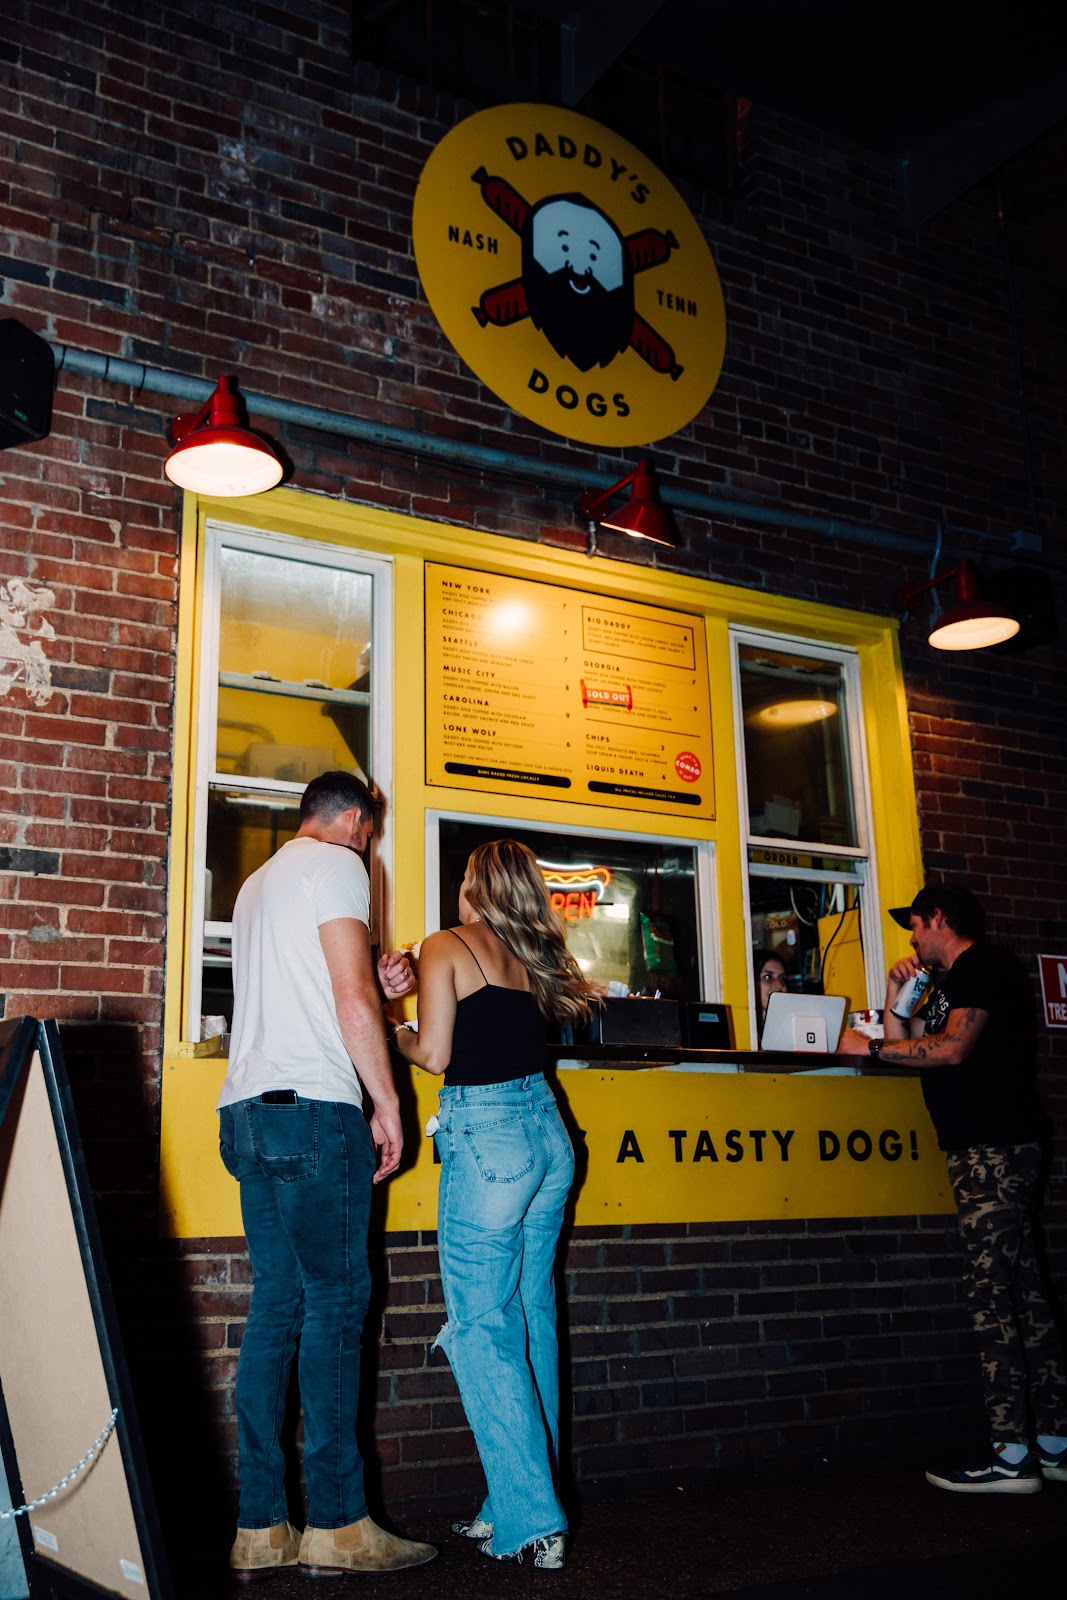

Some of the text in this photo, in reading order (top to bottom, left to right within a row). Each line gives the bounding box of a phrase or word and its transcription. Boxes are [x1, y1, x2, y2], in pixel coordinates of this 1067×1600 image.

[505, 133, 650, 204] DADDY'S
[448, 225, 498, 255] NASH
[656, 289, 698, 317] TENN
[528, 369, 630, 418] DOGS
[442, 580, 490, 595] NEW YORK
[587, 616, 630, 630] BIG DADDY
[442, 635, 477, 647] SEATTLE
[443, 664, 495, 679] MUSIC CITY
[583, 660, 620, 672] GEORGIA
[443, 694, 490, 707] CAROLINA
[586, 690, 630, 702] SOLD OUT
[443, 723, 496, 737] LONE WOLF
[585, 733, 610, 743] CHIPS
[586, 764, 644, 777] LIQUID DEATH
[675, 760, 700, 775] COMBO
[764, 852, 799, 865] ORDER
[550, 891, 597, 920] PEN
[616, 1129, 645, 1164] A
[668, 1129, 796, 1163] TASTY
[820, 1129, 919, 1161] DOG!
